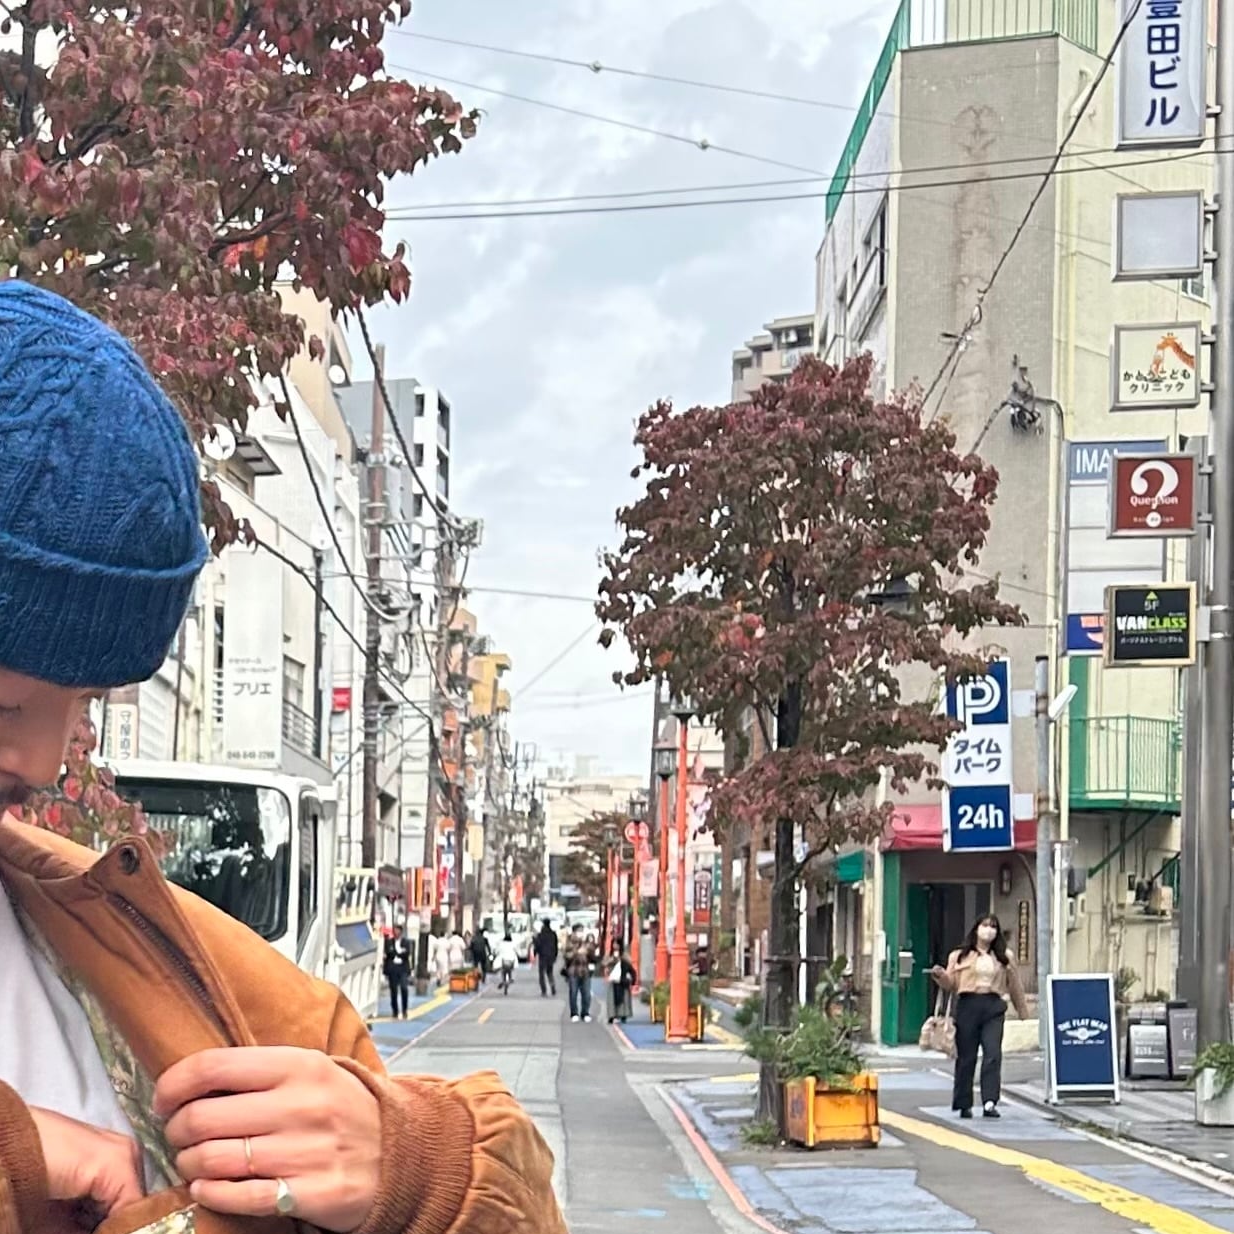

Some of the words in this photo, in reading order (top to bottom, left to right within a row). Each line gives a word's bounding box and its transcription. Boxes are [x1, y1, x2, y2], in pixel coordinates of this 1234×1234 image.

[1129, 381, 1185, 394] クリニック
[1076, 448, 1118, 474] IMA
[953, 738, 1002, 755] タイム
[954, 756, 1002, 774] パーク
[958, 803, 1005, 830] 24h
